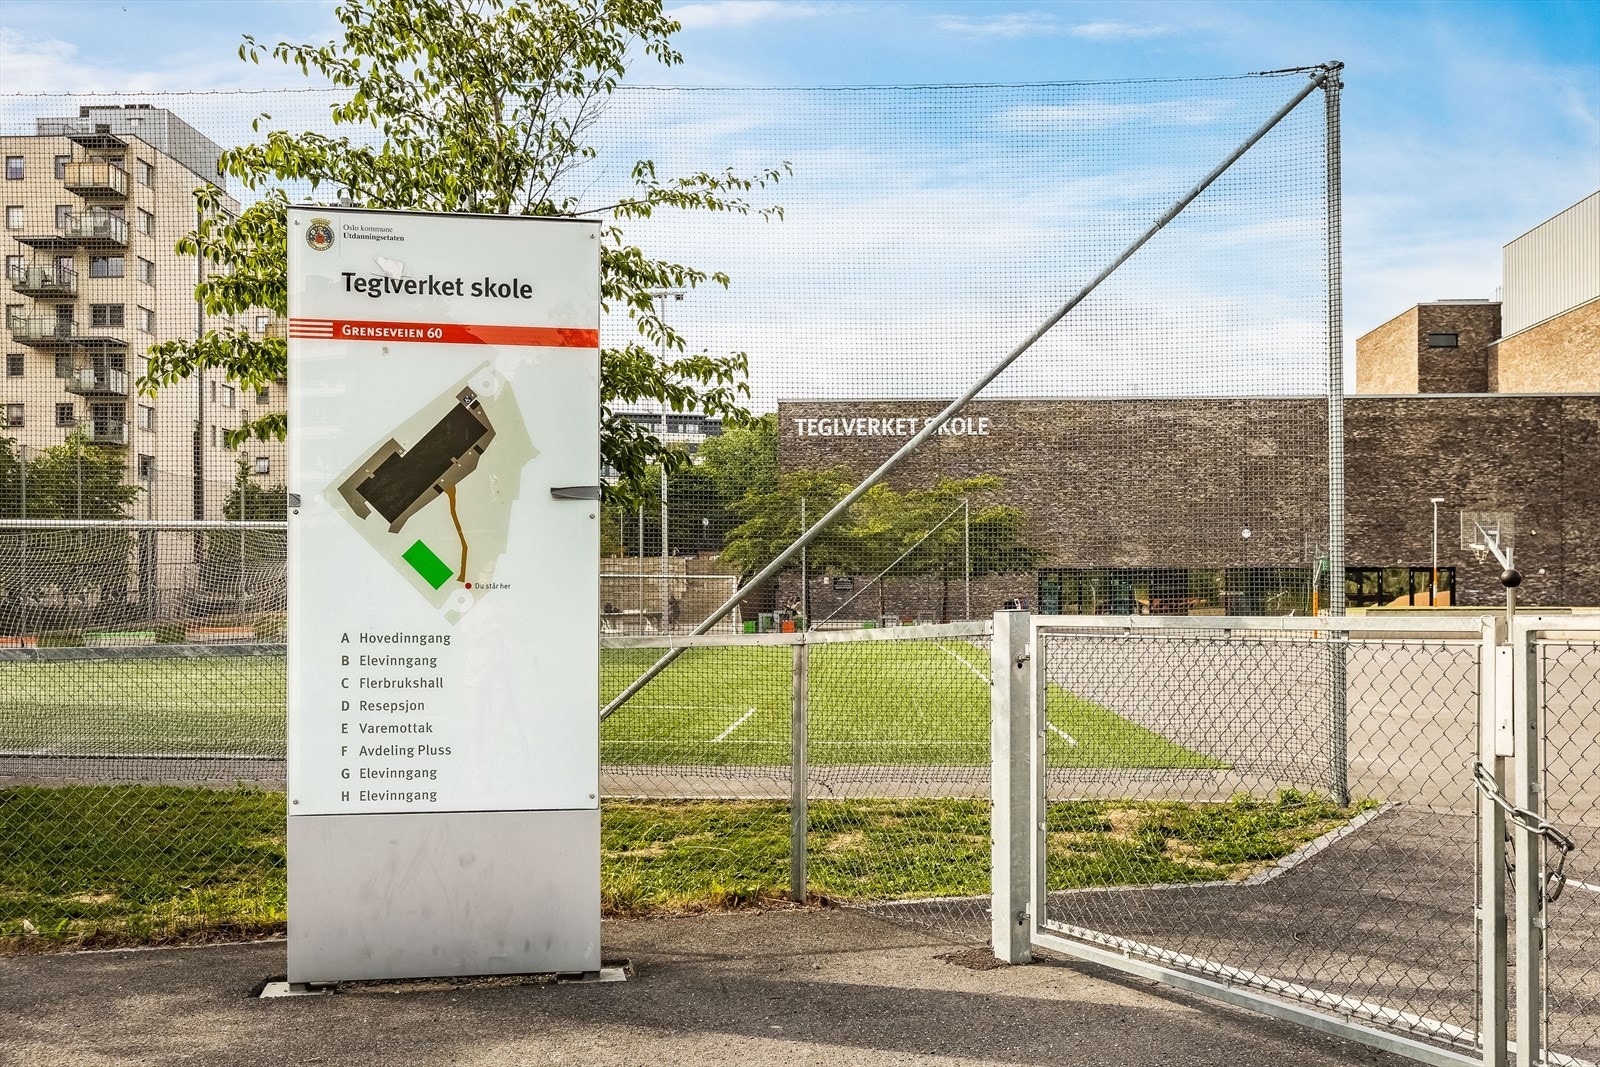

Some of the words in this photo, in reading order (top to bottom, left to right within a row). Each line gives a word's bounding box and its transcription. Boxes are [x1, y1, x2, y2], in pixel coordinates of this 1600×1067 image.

[361, 225, 394, 233] kommune
[343, 232, 405, 242] Utdanningsetaten
[341, 271, 464, 299] Teglverket
[471, 276, 533, 299] skole
[427, 327, 443, 339] 60
[795, 418, 920, 436] TEGLVERKET
[475, 582, 484, 590] Du
[485, 582, 499, 590] står
[500, 582, 511, 590] her
[341, 633, 350, 644] A
[359, 632, 451, 646] Hovedinngang
[341, 655, 350, 666] B
[359, 655, 438, 668] Elevinngang
[341, 677, 350, 689] C
[359, 677, 444, 689] Flerbrukshall
[341, 700, 350, 711] D
[359, 700, 425, 714] Resepsjon
[341, 723, 349, 734] E
[359, 722, 433, 734] Varemottak
[341, 746, 348, 756] F
[359, 745, 415, 758] Avdeling
[418, 744, 452, 756] Pluss
[341, 768, 350, 779] G
[359, 768, 438, 781] Elevinngang
[341, 791, 350, 802] H
[359, 791, 438, 803] Elevinngang
